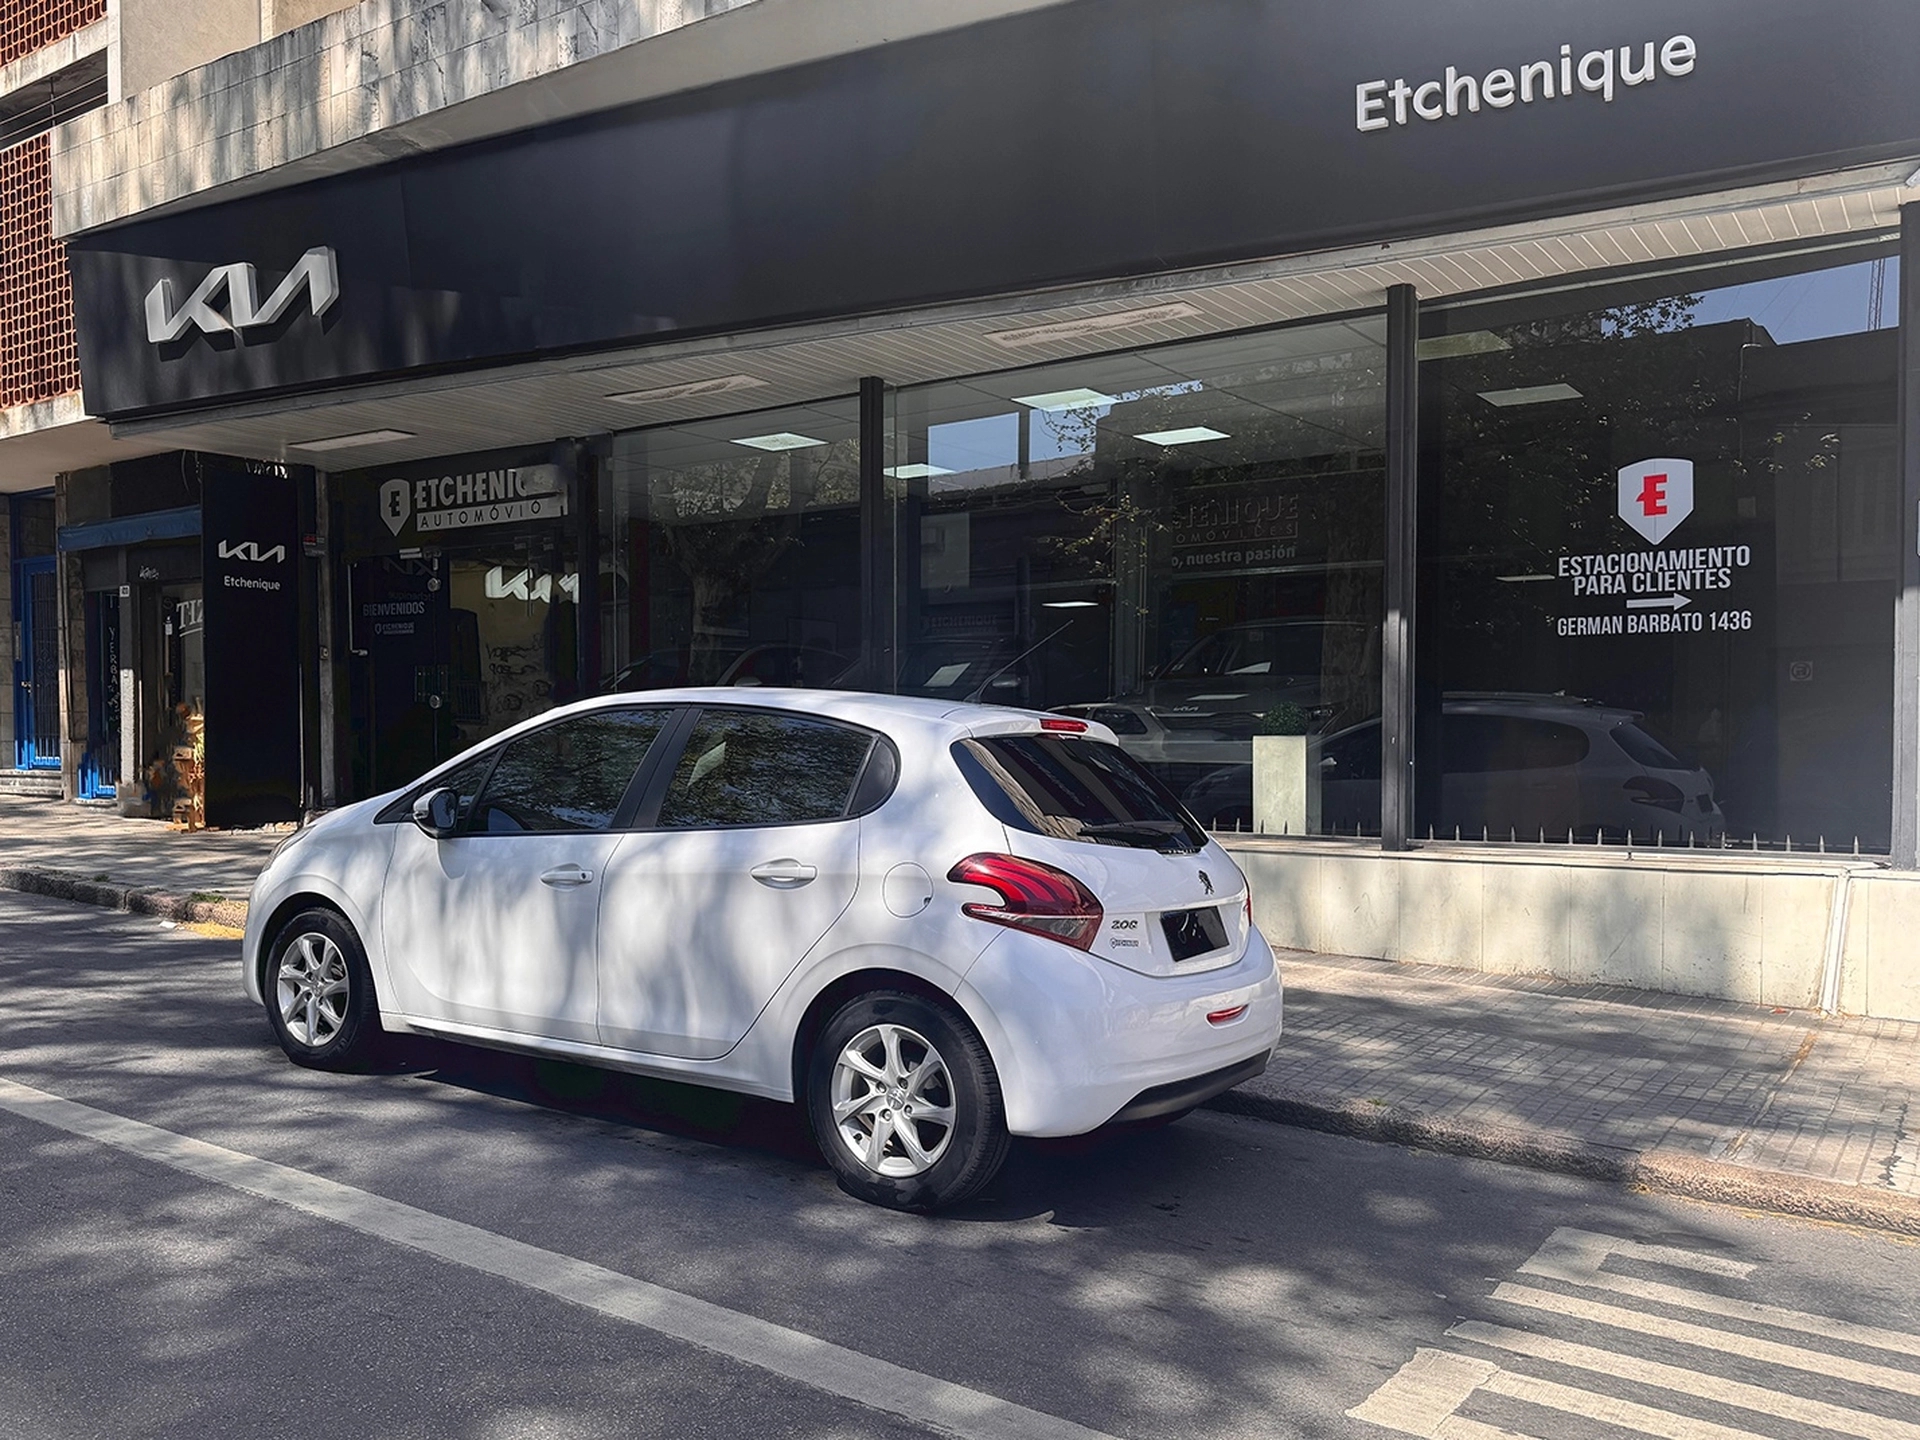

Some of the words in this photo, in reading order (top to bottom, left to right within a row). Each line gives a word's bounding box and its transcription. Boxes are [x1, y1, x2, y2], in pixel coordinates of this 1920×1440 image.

[1356, 34, 1697, 132] Etchenique
[145, 246, 339, 343] KIA
[218, 540, 285, 563] KIA
[1186, 549, 1242, 567] nuestra
[1245, 543, 1296, 565] pasión
[1558, 545, 1750, 577] ESTACIONAMIENTO
[223, 576, 281, 591] Etchenique
[1573, 574, 1627, 596] PARA
[1632, 568, 1731, 593] CLIENTES
[362, 601, 425, 617] BIENVENIDOS
[1557, 615, 1623, 637] GERMAN
[1627, 612, 1703, 634] BARBATO
[1709, 610, 1752, 632] 1436
